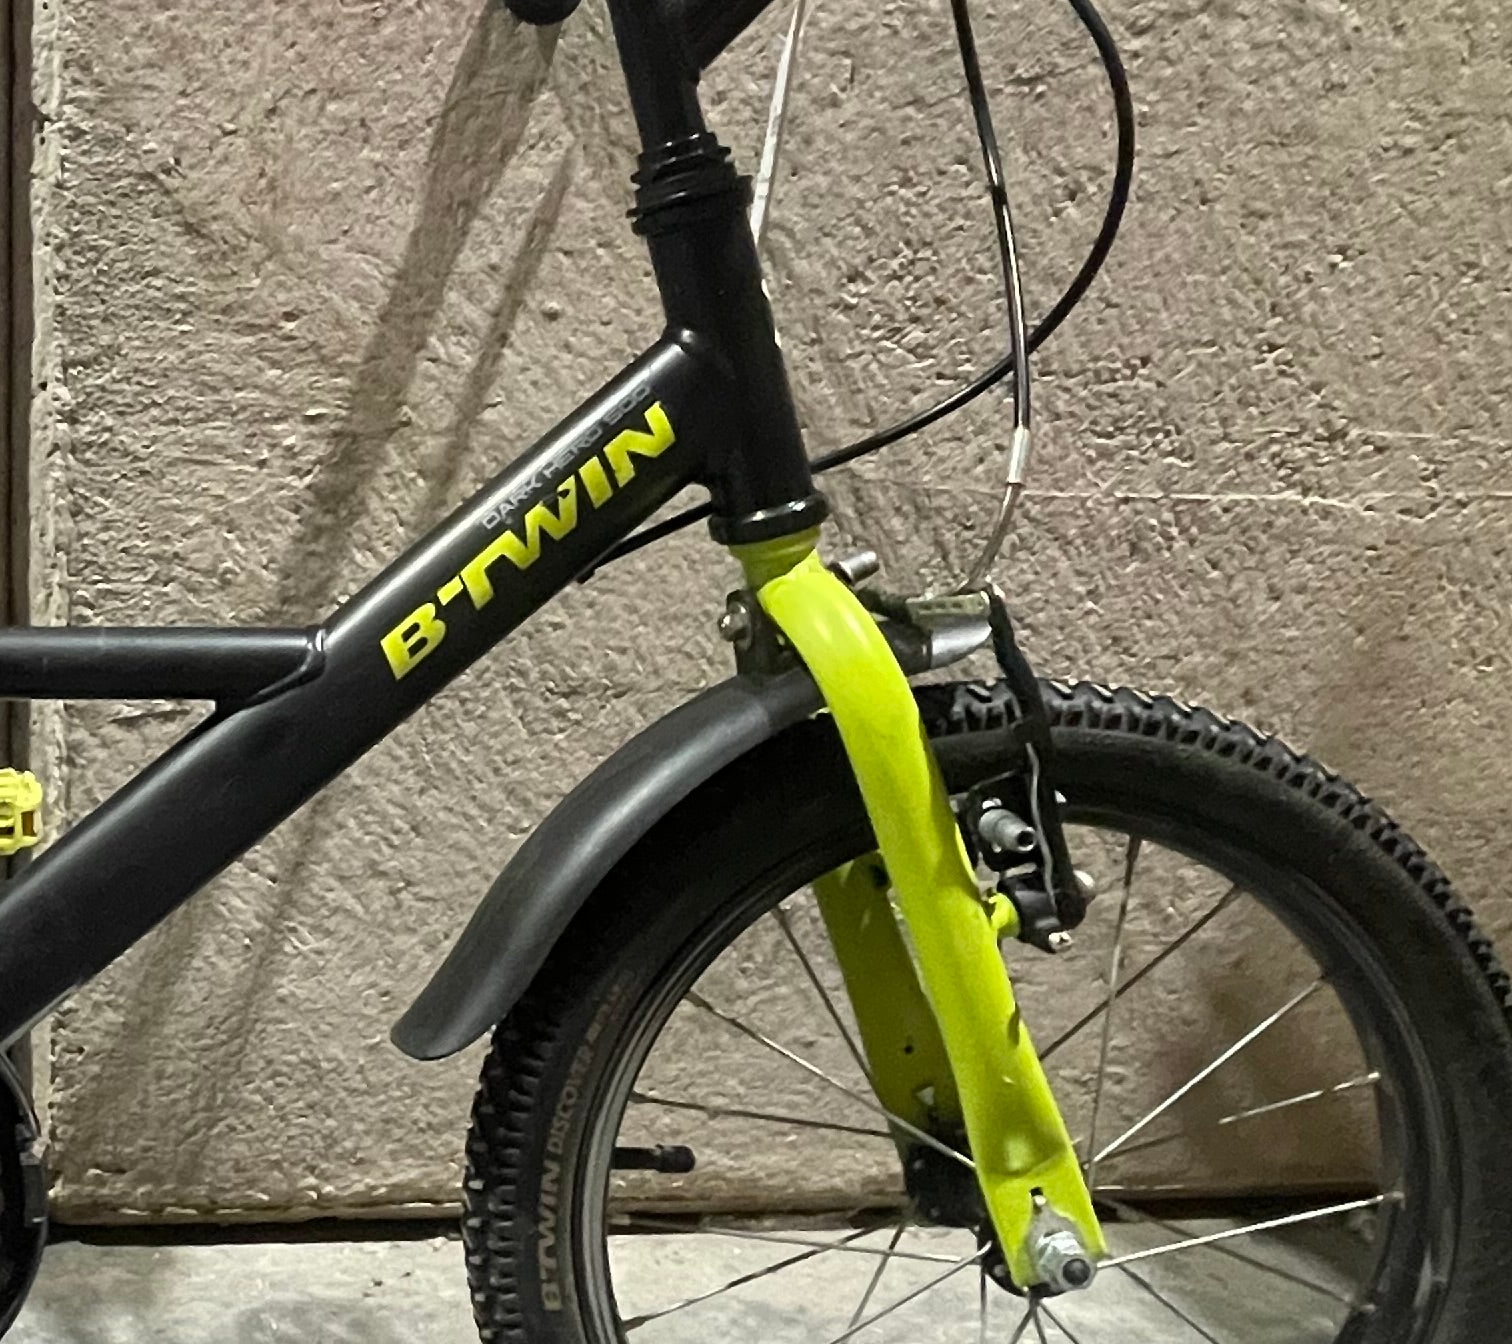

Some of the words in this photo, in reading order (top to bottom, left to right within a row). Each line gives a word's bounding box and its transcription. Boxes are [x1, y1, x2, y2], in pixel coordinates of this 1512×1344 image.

[482, 476, 543, 530] DARK
[542, 425, 604, 480] HERO
[604, 384, 651, 427] 500
